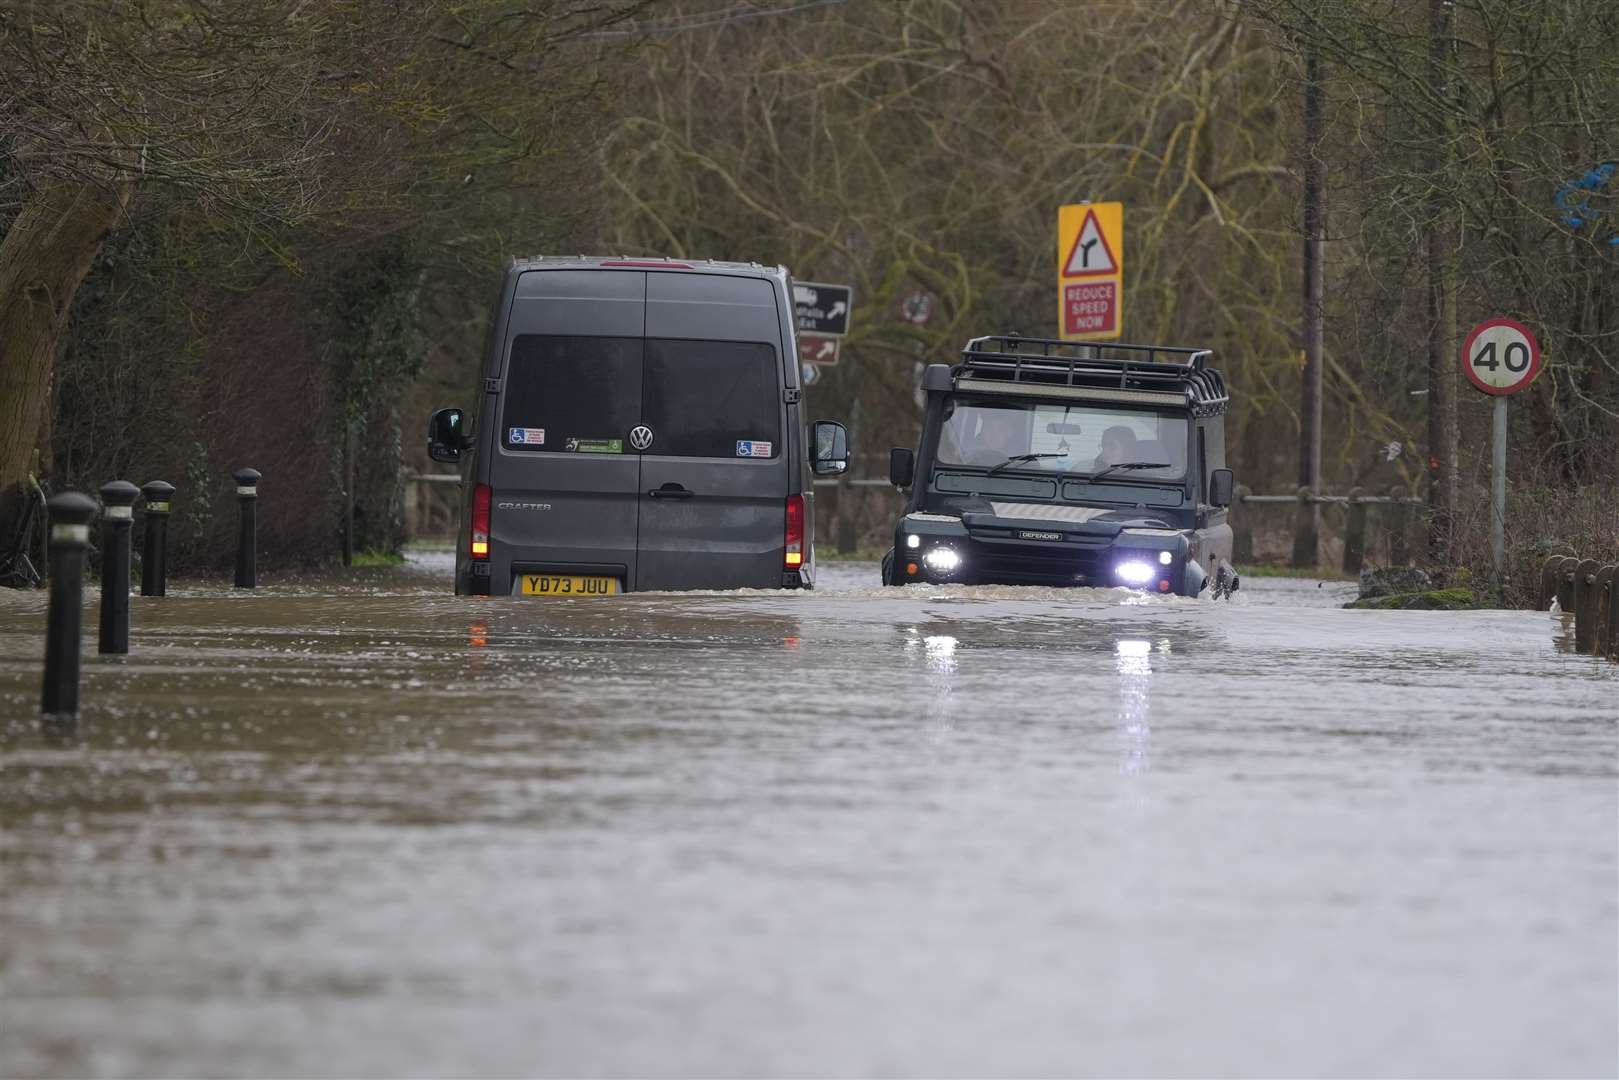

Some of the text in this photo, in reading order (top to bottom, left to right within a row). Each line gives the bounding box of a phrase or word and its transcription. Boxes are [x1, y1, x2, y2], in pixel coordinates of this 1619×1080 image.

[1067, 286, 1112, 301] REDUCE
[1072, 301, 1108, 315] SPEED
[1076, 316, 1104, 328] NOW
[1473, 341, 1530, 373] 40
[498, 502, 551, 511] CRAFTER
[529, 577, 608, 594] YD73 JUU
